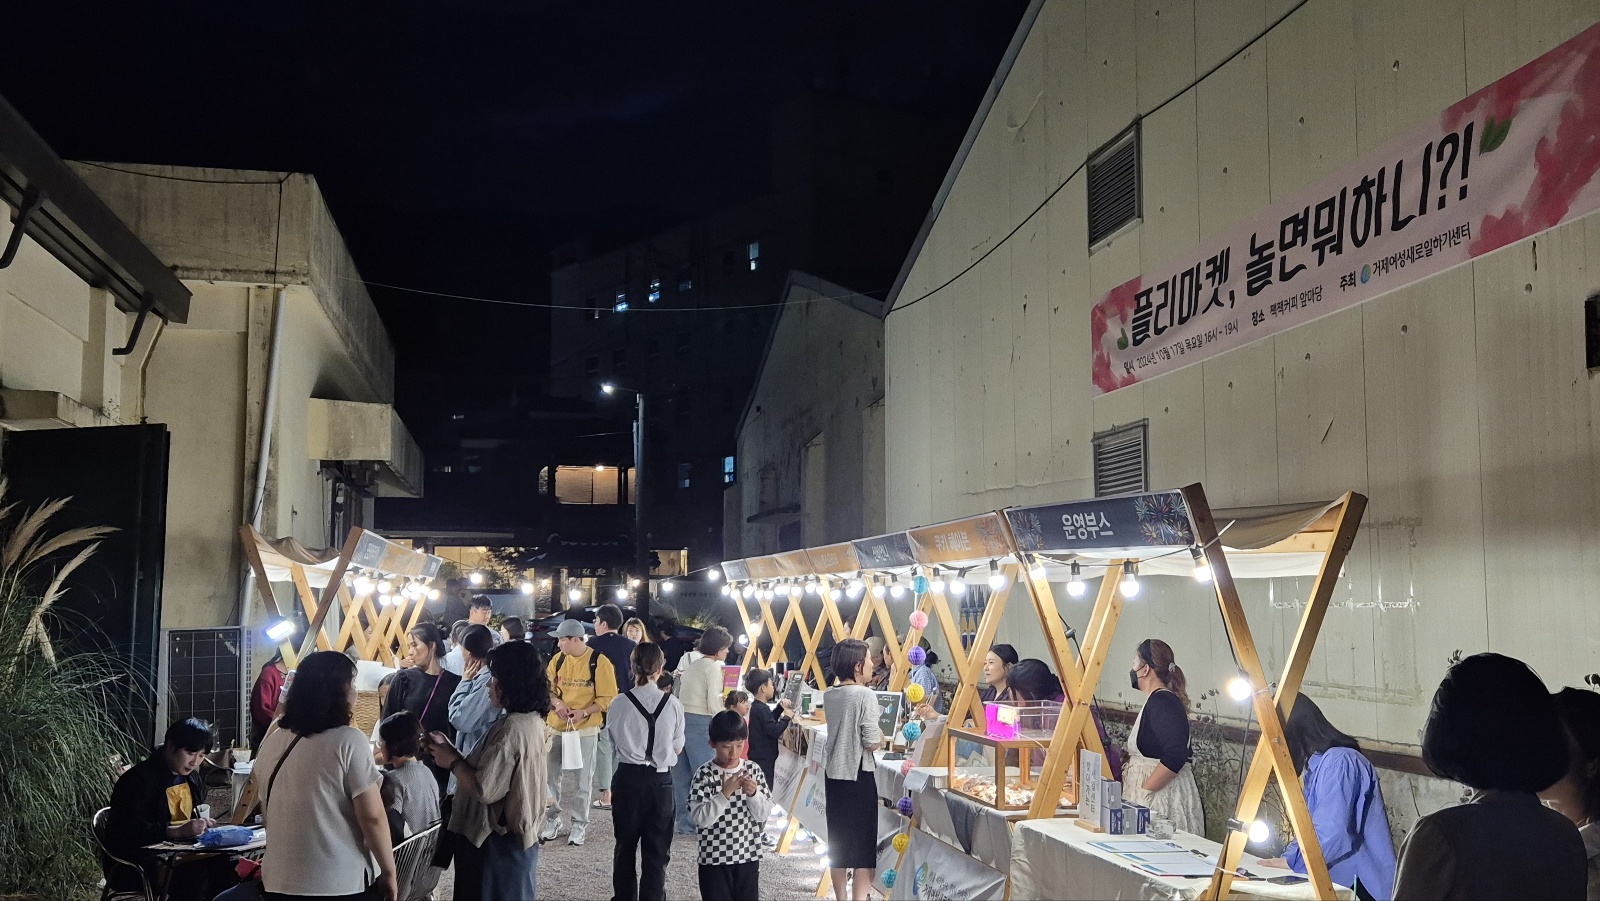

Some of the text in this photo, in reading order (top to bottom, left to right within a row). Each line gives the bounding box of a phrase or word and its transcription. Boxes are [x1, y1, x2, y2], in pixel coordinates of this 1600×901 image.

[1131, 121, 1474, 347] 플리마켓, 놀면뭐하니?!
[1137, 352, 1157, 368] 2024년
[1156, 347, 1171, 362] 10월
[1170, 341, 1185, 356] 17일
[1185, 333, 1203, 352] 목요일
[1251, 309, 1266, 326] 장소
[1300, 284, 1322, 308] 앞마당
[1339, 271, 1356, 292] 주최
[1372, 222, 1471, 277] 거제여성새로일하기센터
[1062, 511, 1114, 540] 운영부스
